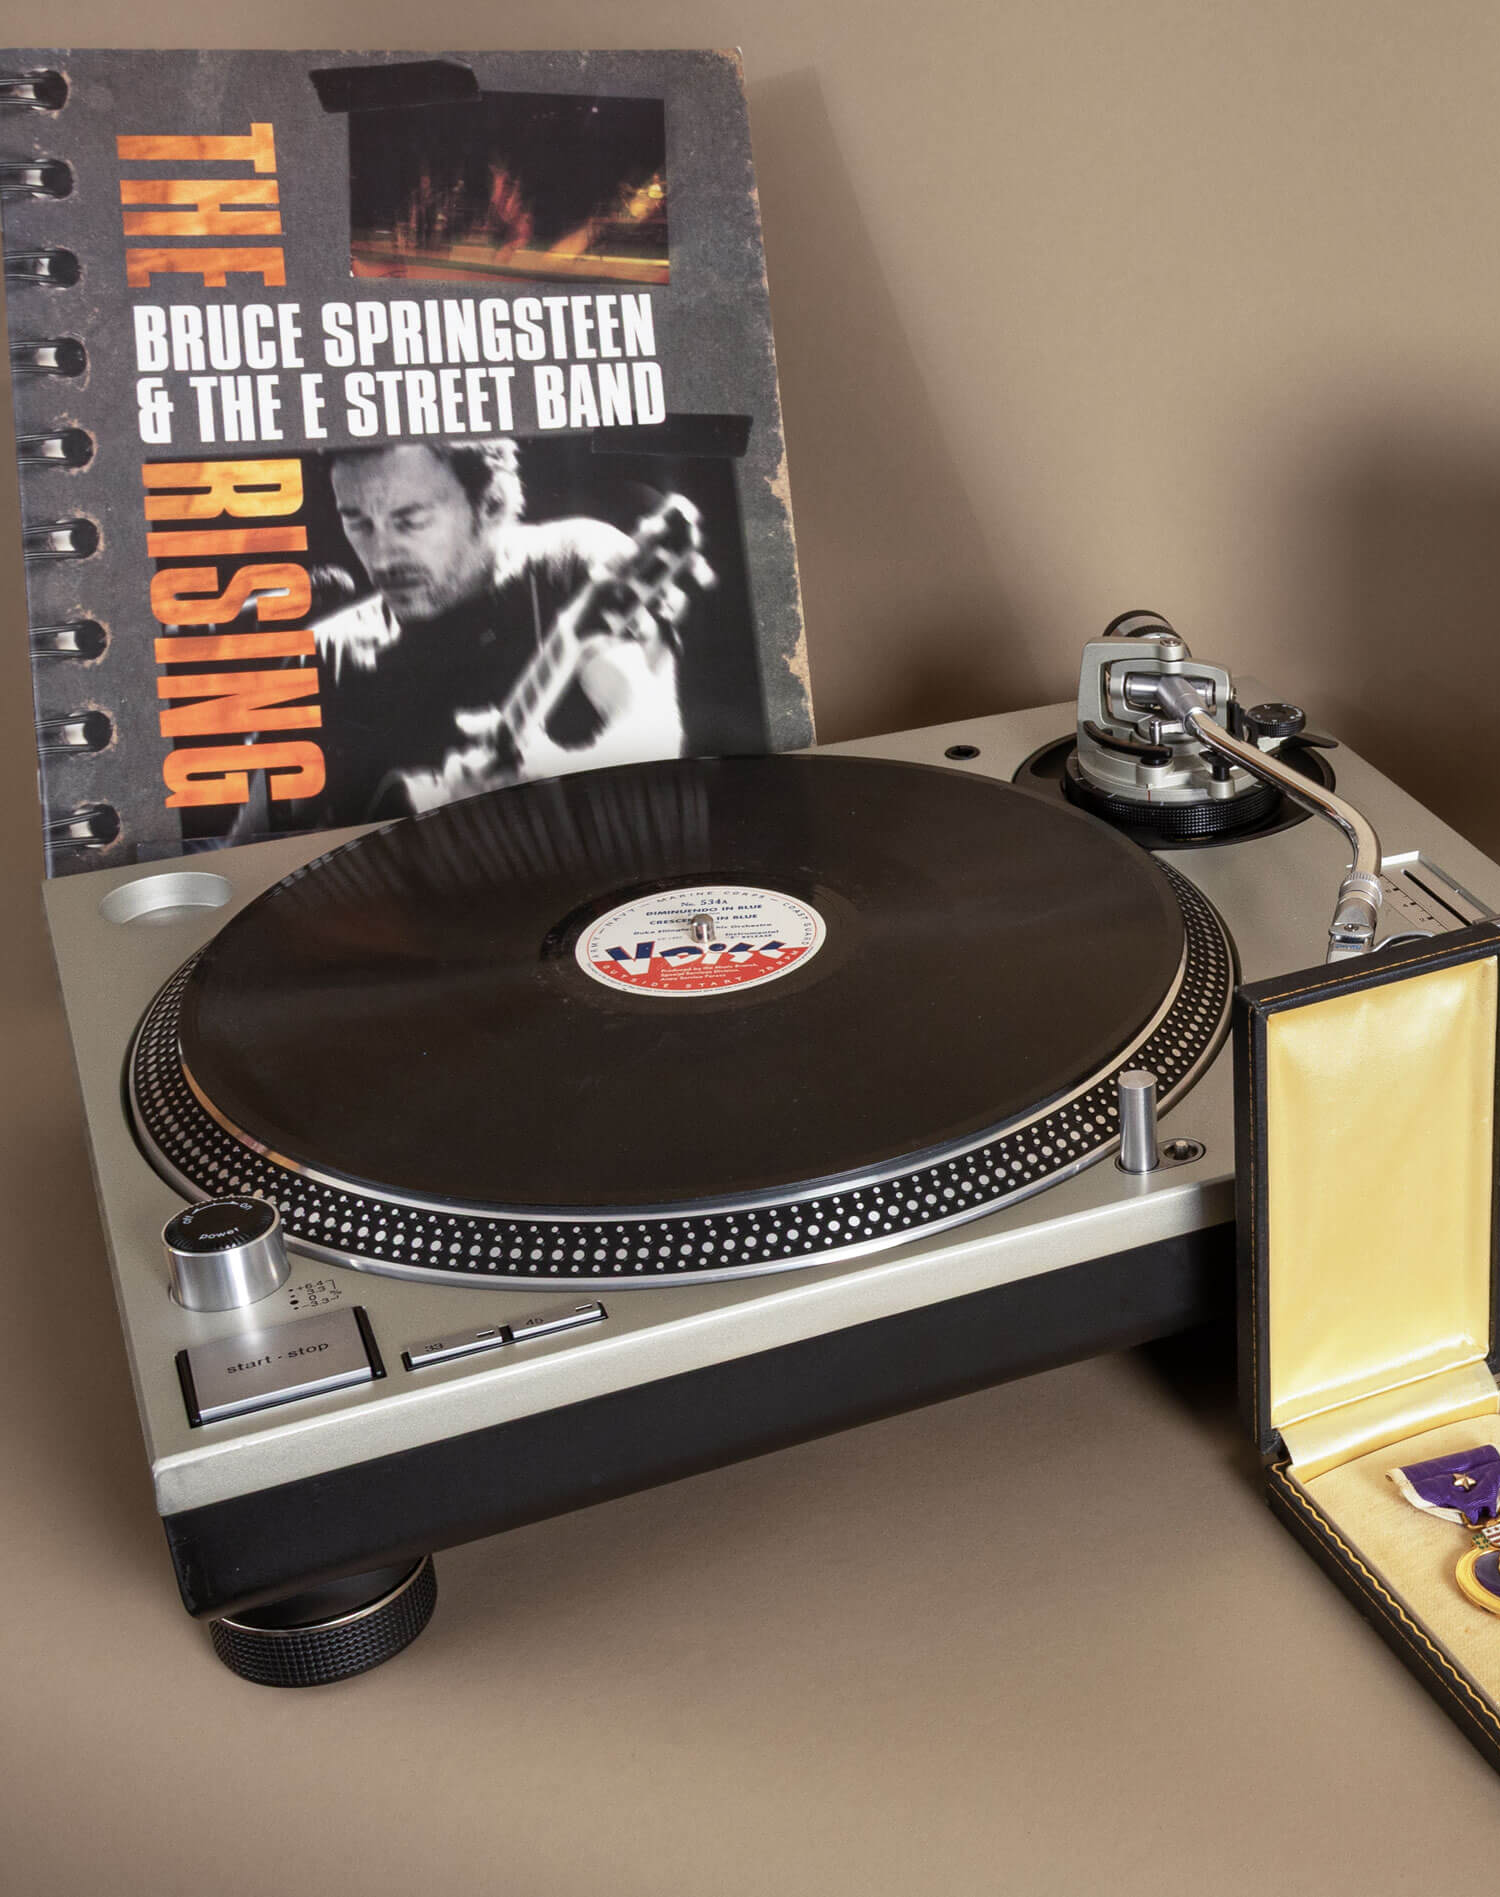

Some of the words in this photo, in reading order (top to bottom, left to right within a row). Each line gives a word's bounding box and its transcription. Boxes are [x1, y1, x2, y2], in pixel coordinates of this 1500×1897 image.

[116, 123, 286, 288] THE
[133, 303, 304, 373] BRUCE
[323, 293, 657, 367] SPRINGSTEEN
[136, 377, 172, 444] &
[190, 373, 284, 442] THE
[302, 372, 326, 440] E
[346, 366, 516, 438] STREET
[534, 361, 666, 430] BAND
[141, 457, 327, 809] RISING
[605, 907, 635, 928] NAVY
[657, 891, 713, 903] MARINE
[723, 891, 765, 899] CORPS
[783, 902, 809, 920] COAST
[646, 906, 718, 916] DIMINUENDO
[605, 940, 655, 976] V
[602, 964, 670, 988] OUTSIDE
[685, 976, 742, 989] START
[198, 1226, 240, 1241] power
[425, 1342, 444, 1352] 33
[525, 1316, 544, 1326] 45
[226, 1354, 273, 1374] start
[287, 1341, 329, 1362] stop
